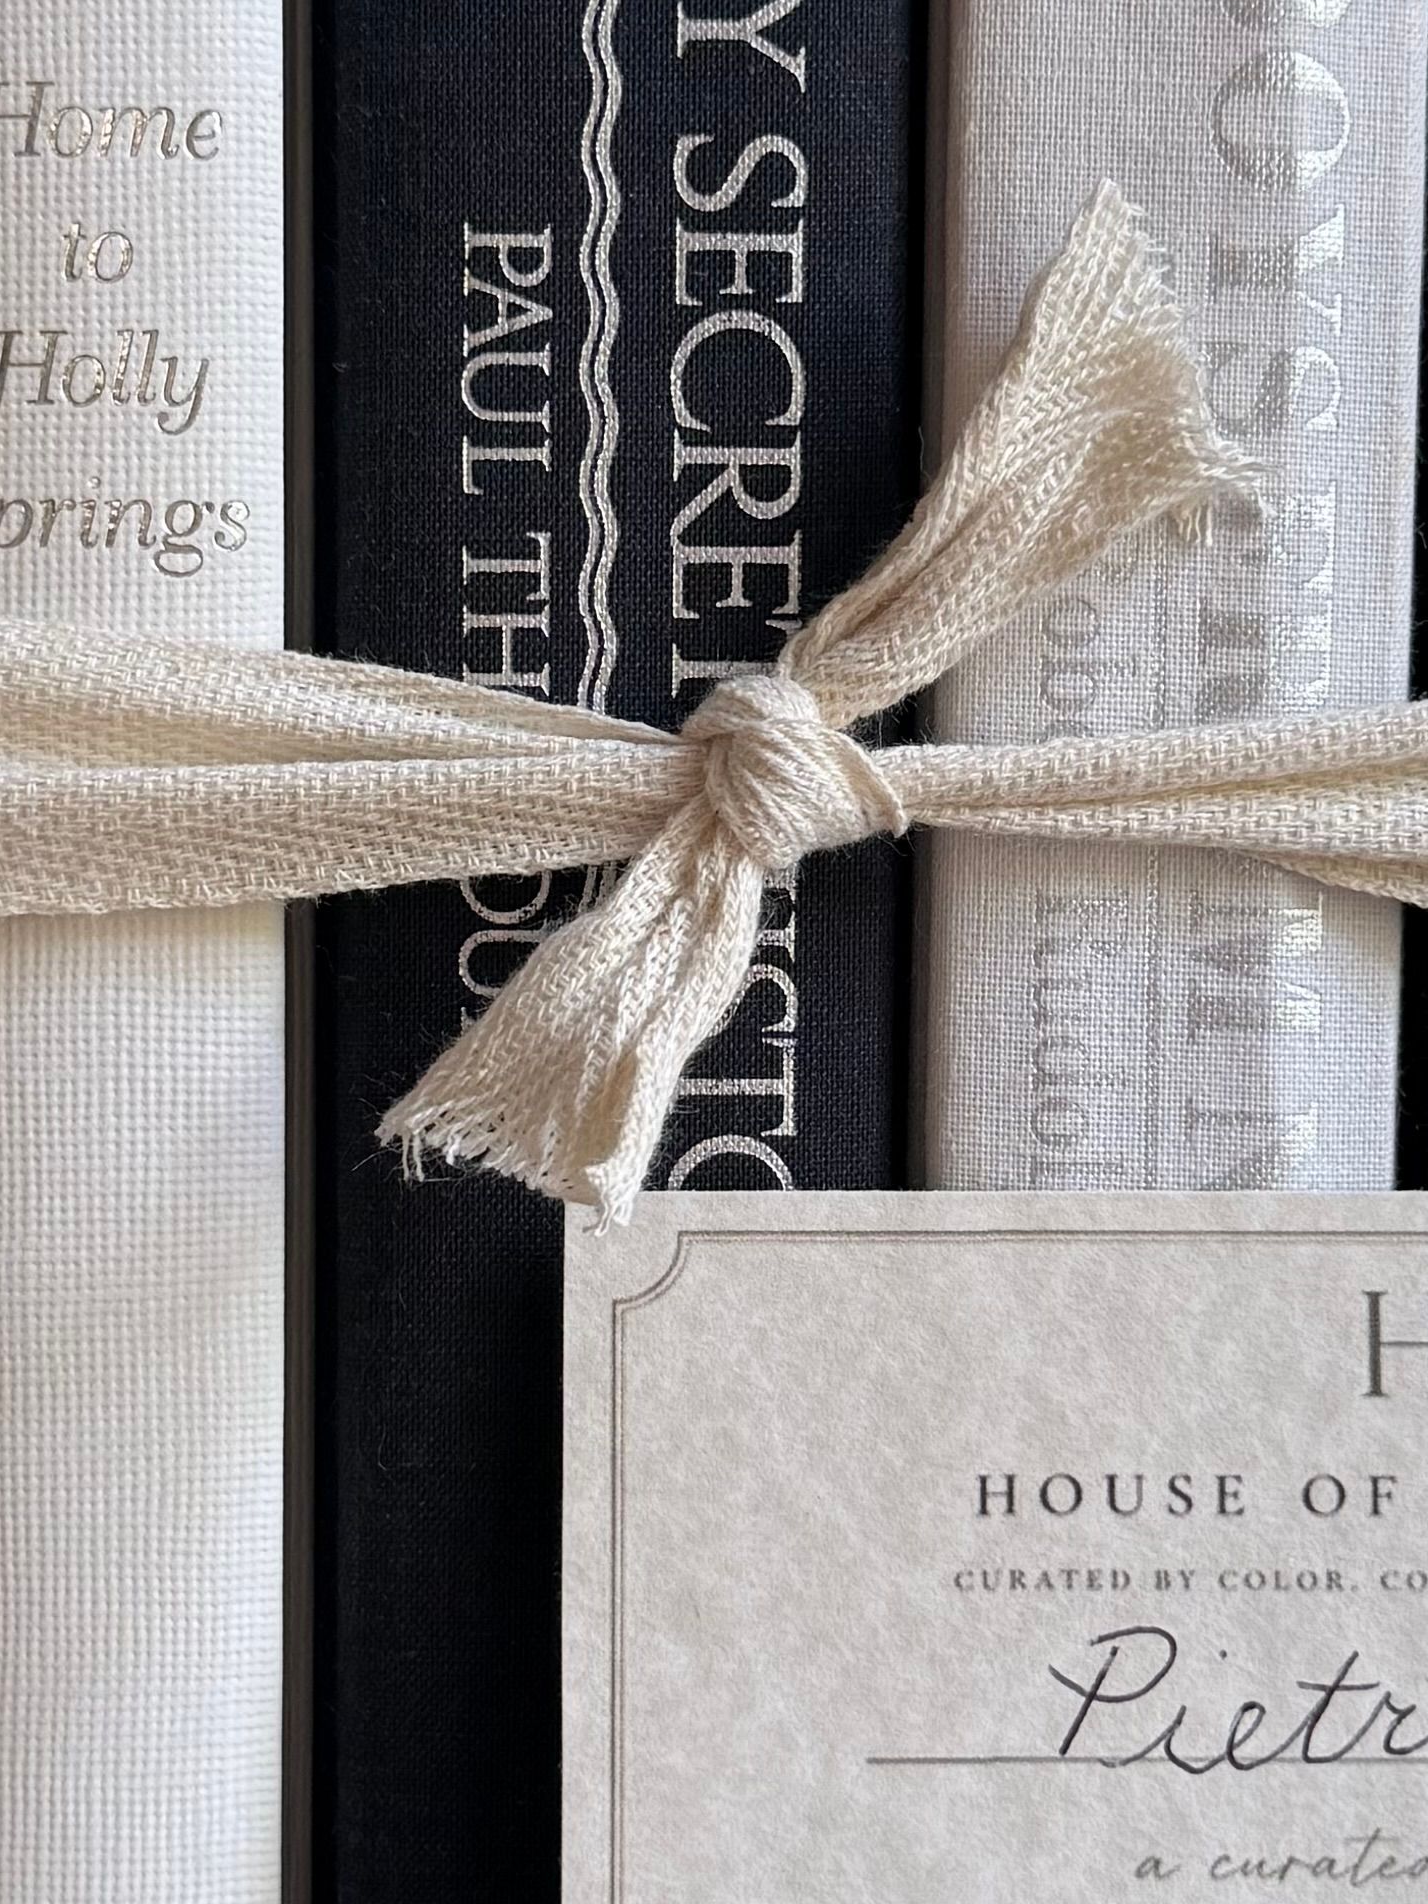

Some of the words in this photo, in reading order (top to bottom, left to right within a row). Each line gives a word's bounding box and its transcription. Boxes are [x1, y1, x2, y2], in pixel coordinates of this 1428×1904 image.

[59, 216, 136, 284] to
[461, 222, 554, 497] PAUL
[670, 133, 808, 698] SECRET
[977, 1473, 1245, 1518] HOUSE
[1301, 1474, 1398, 1518] OF
[952, 1567, 1132, 1593] CURATED
[1153, 1568, 1196, 1593] BY
[1217, 1568, 1359, 1594] COLOR.
[1133, 1854, 1181, 1882] a
